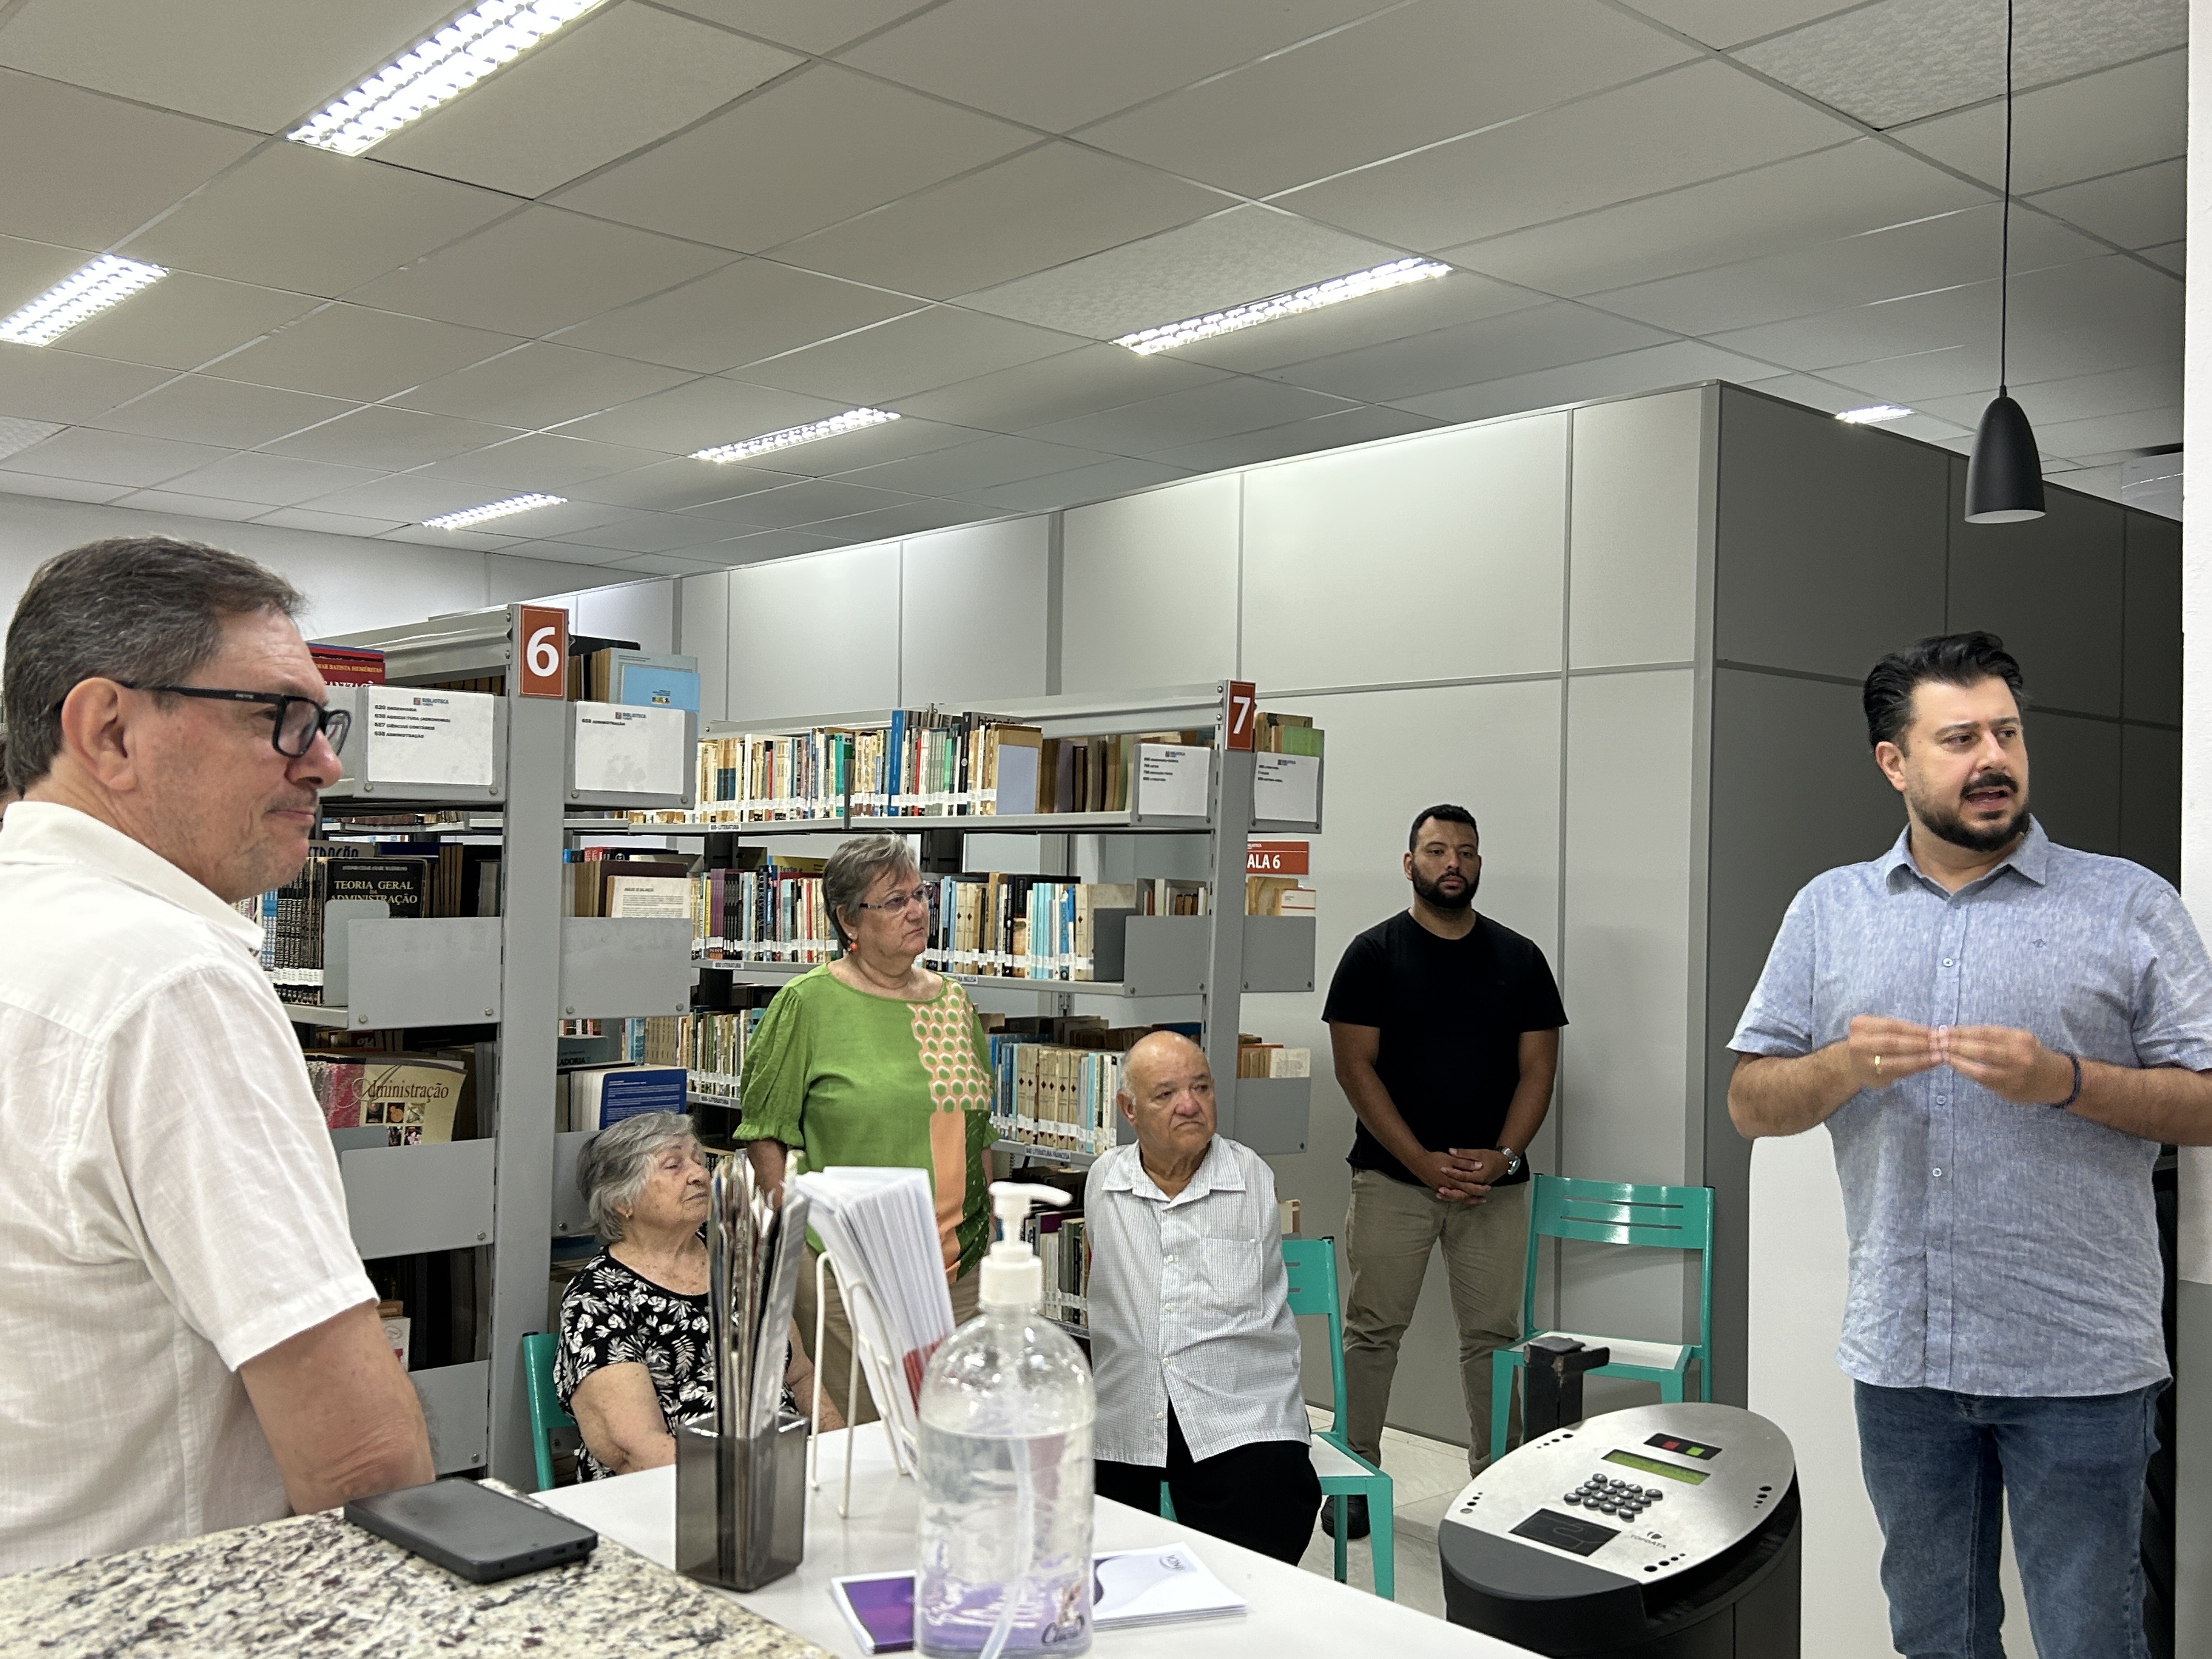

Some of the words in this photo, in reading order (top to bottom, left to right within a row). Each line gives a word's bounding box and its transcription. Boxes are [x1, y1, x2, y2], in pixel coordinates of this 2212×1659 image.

[526, 627, 560, 677] 6
[1232, 696, 1251, 735] 7
[1272, 854, 1281, 869] 6
[334, 880, 374, 890] TEORIA
[377, 880, 414, 890] GERAL
[350, 1065, 449, 1104] Administração
